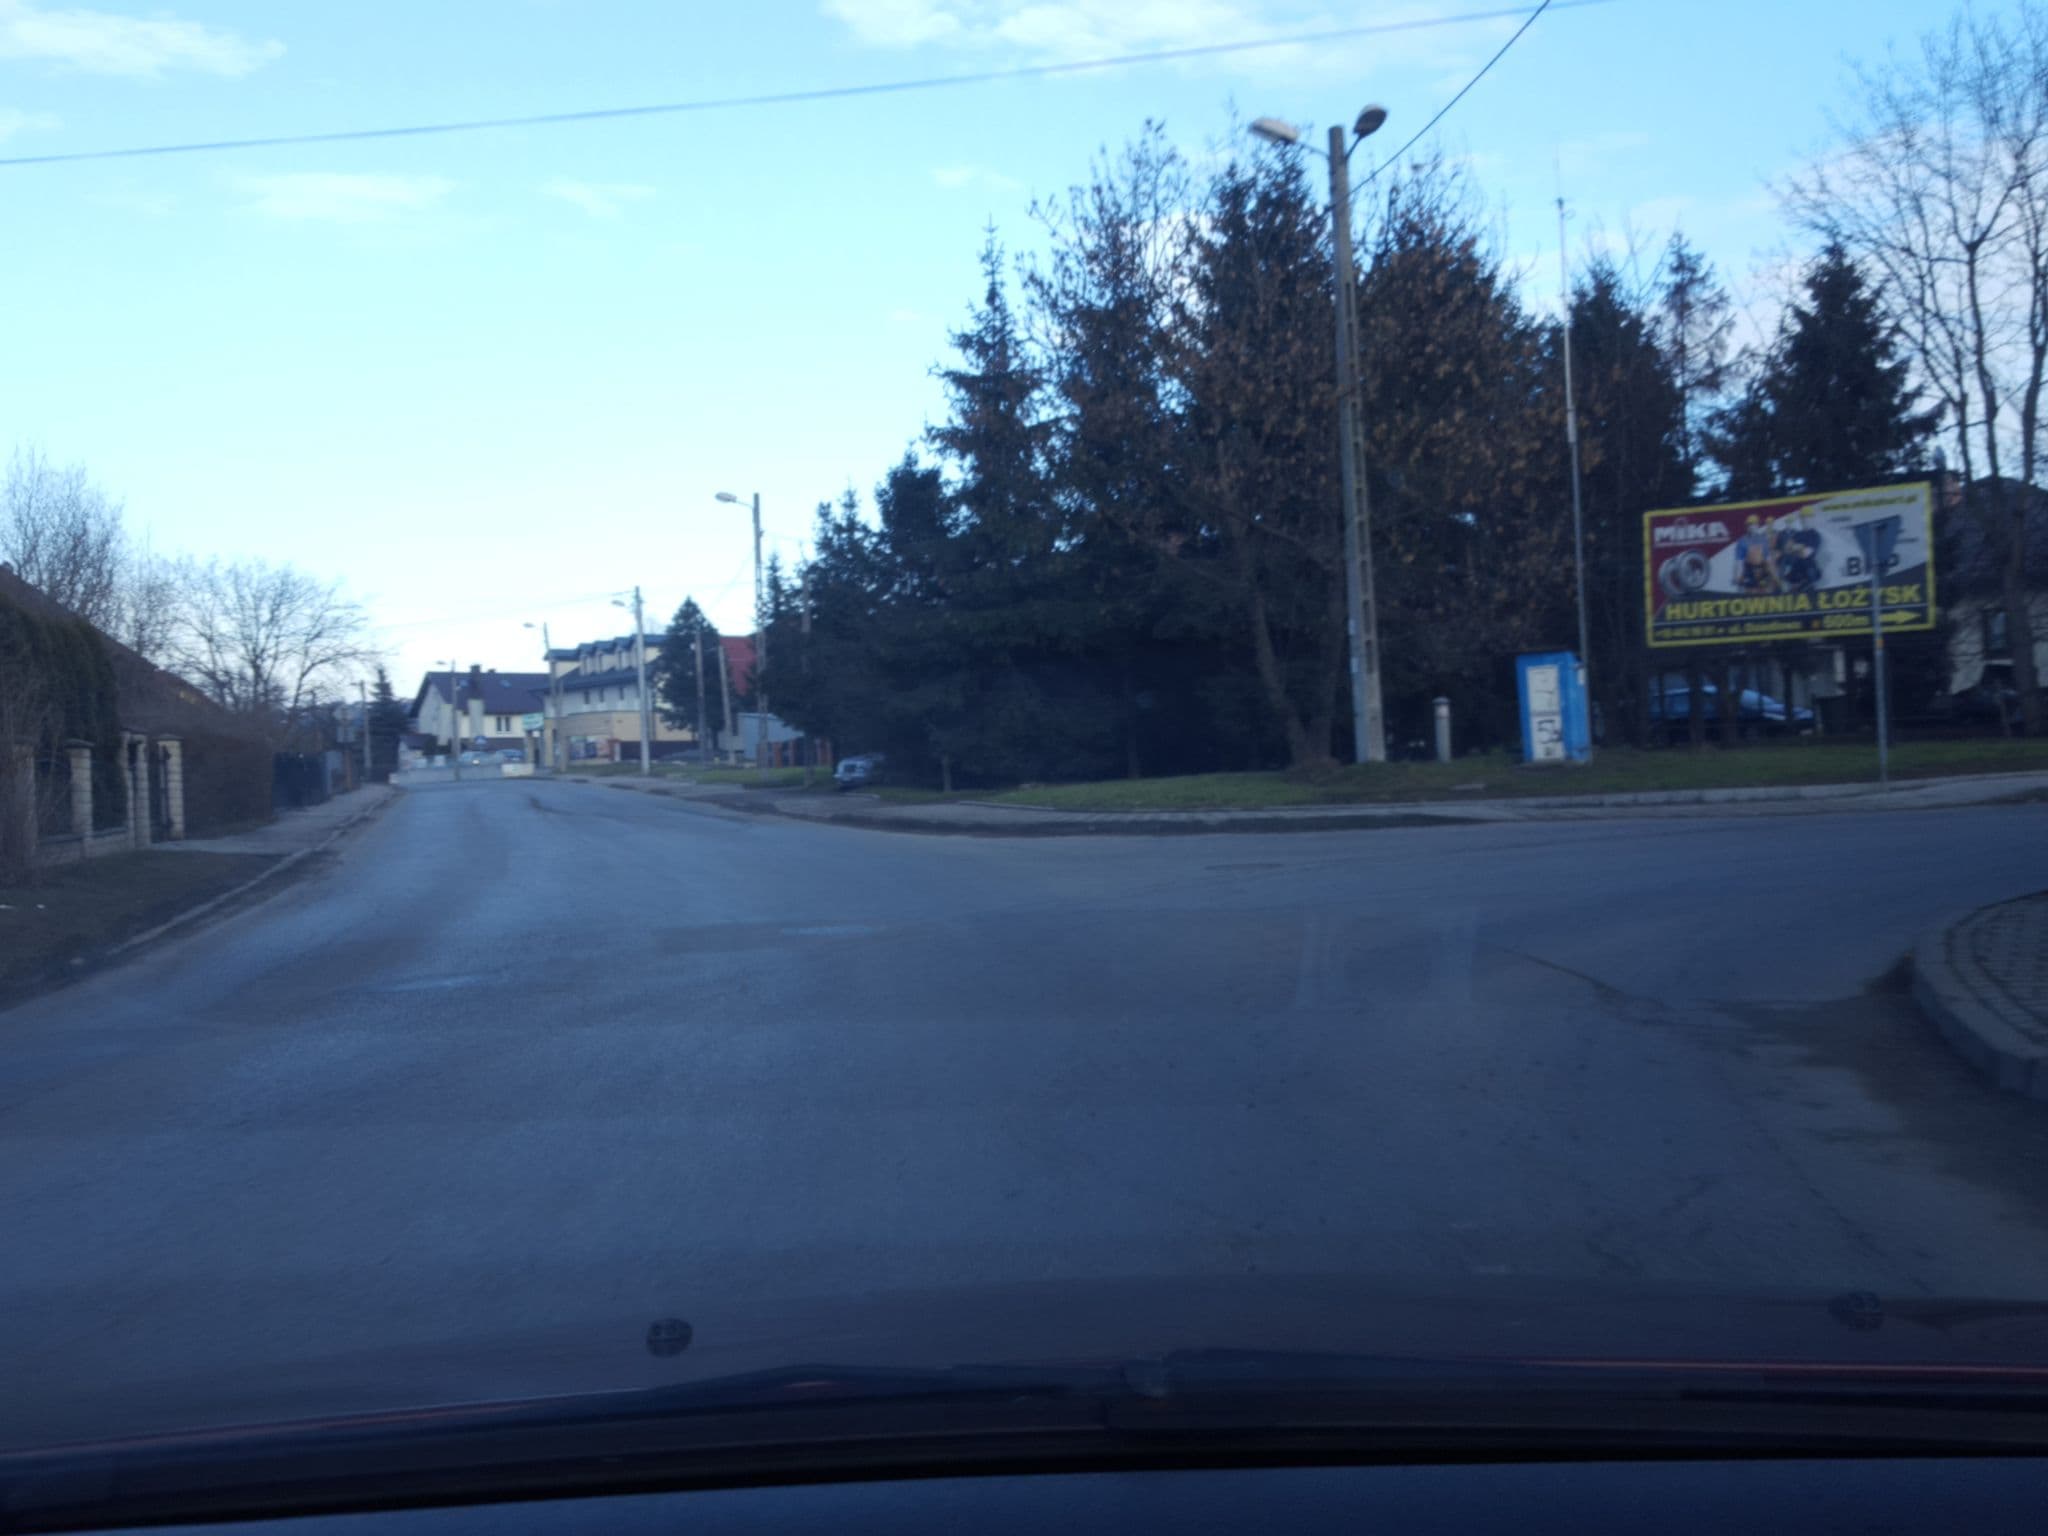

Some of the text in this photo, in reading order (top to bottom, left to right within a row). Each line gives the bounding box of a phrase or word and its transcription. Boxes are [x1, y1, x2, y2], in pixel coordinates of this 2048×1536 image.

[1654, 520, 1729, 542] MIKA
[1665, 584, 1920, 620] HURTOWNIA ŁOŻSK
